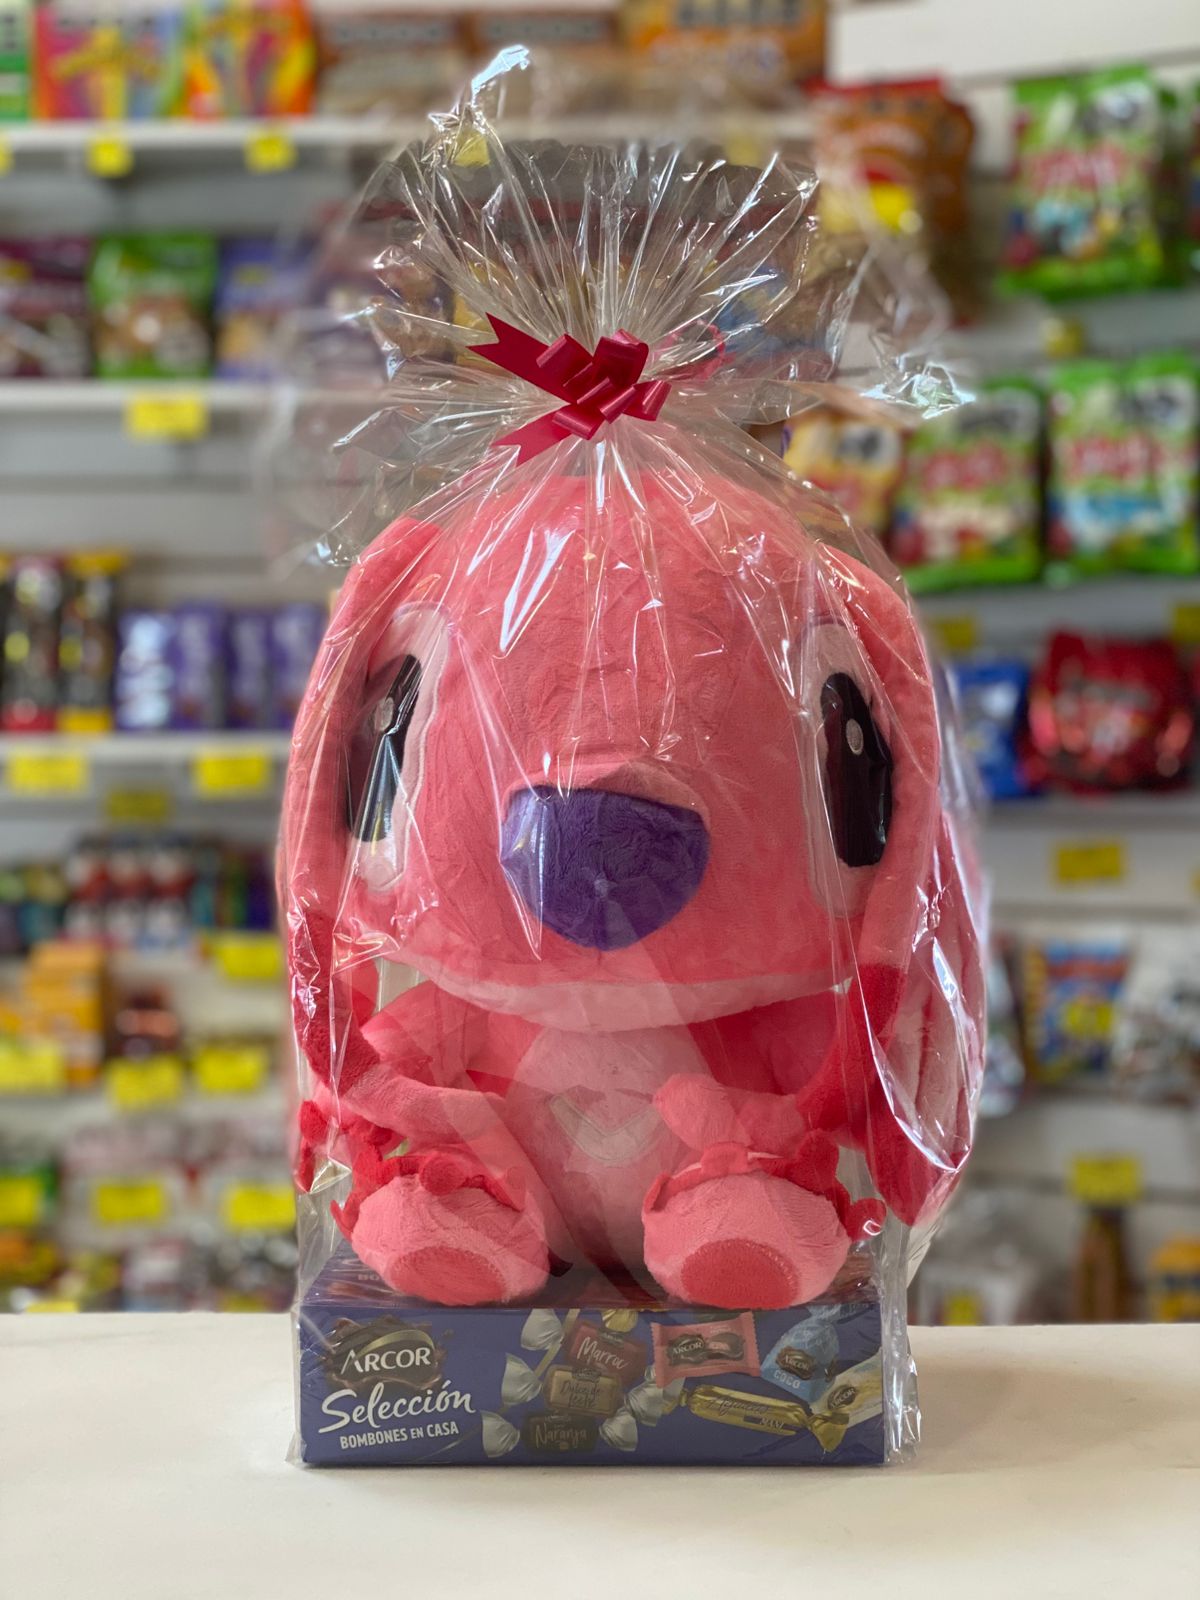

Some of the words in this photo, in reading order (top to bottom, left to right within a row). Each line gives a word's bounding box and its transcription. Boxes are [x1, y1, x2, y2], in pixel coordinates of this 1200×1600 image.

[341, 1347, 432, 1375] ARCOR
[577, 1337, 630, 1370] Marroc
[773, 1370, 801, 1390] COCO
[318, 1380, 476, 1433] Selección
[339, 1428, 408, 1449] BOMBONES
[426, 1421, 459, 1437] CASA
